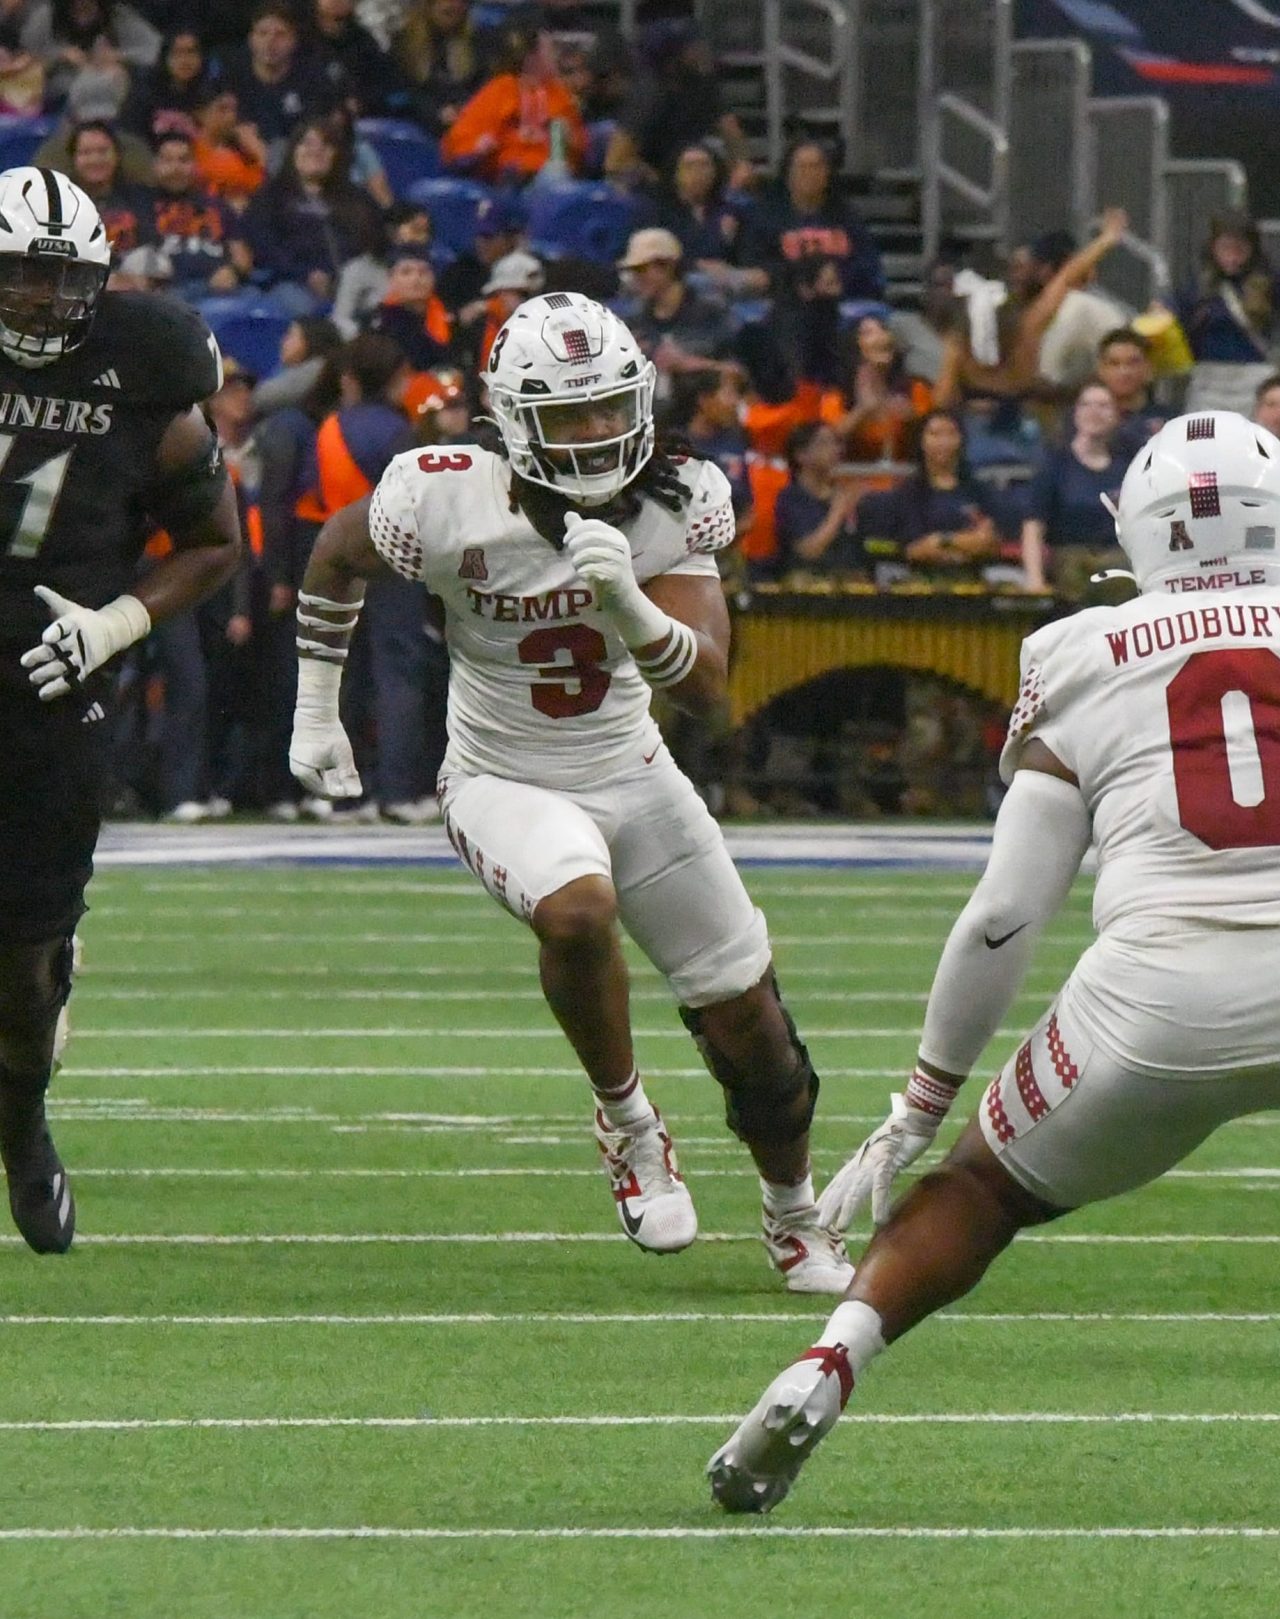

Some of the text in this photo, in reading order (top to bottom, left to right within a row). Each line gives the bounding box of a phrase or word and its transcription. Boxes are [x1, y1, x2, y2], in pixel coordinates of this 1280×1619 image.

[37, 240, 71, 252] UTSA
[563, 373, 603, 389] TUFF
[1165, 570, 1266, 593] TEMPLE
[467, 587, 603, 622] TEMP
[518, 623, 612, 719] 3
